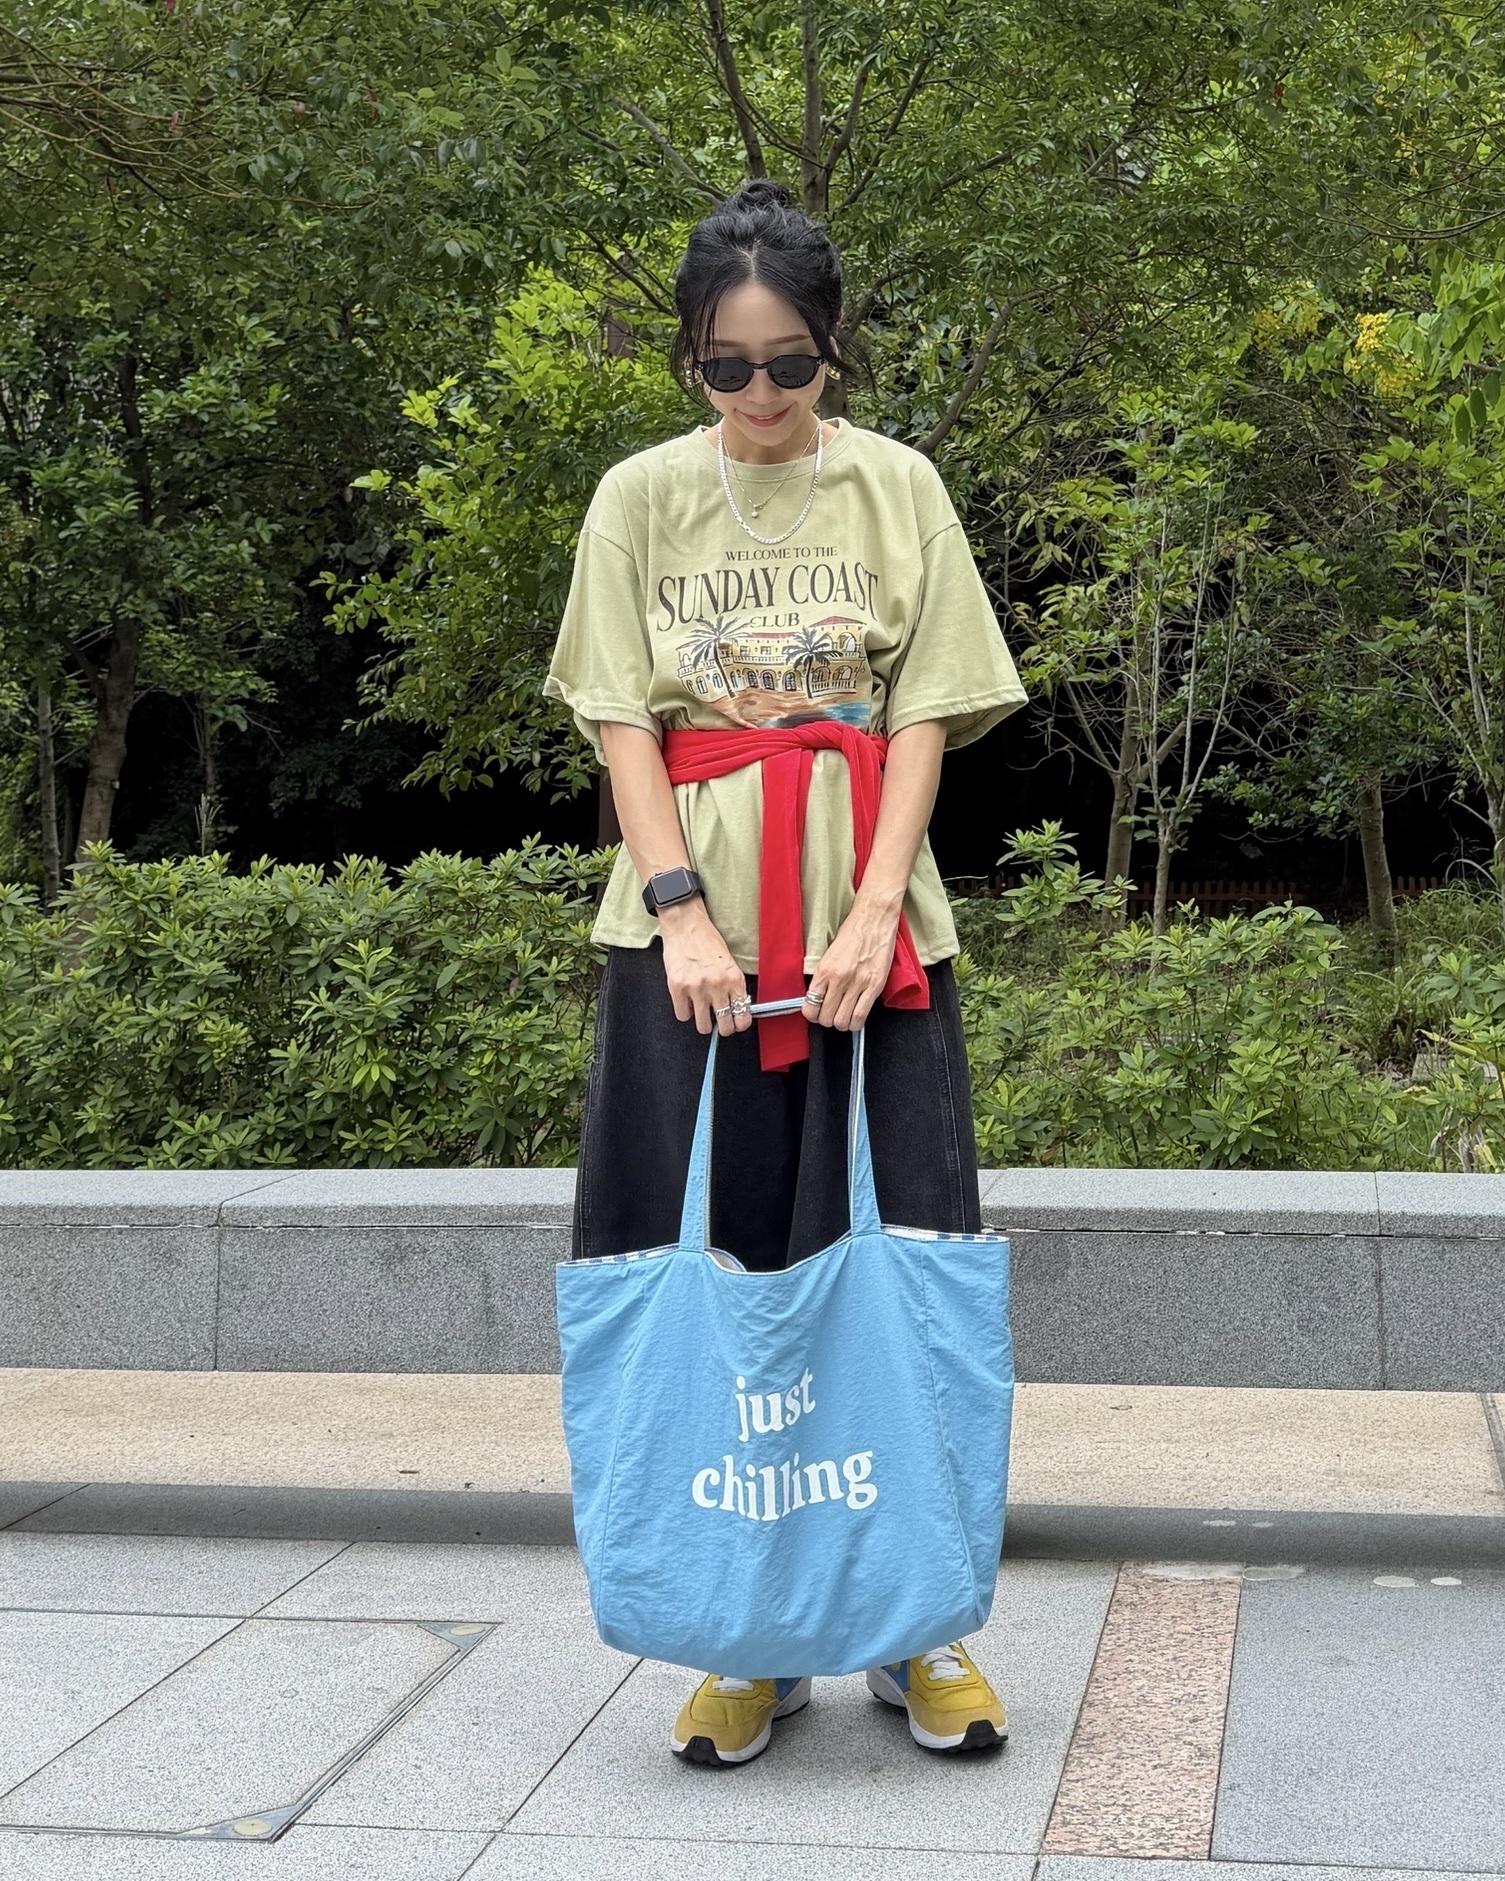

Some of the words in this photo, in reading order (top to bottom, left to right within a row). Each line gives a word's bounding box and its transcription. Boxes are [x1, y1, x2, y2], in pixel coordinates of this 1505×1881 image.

[725, 548, 791, 561] WELCOME
[793, 547, 811, 559] TO
[813, 546, 838, 557] THE
[657, 567, 781, 632] SUNDAY
[788, 561, 878, 622] COAST
[749, 612, 800, 628] CLUB
[735, 1367, 816, 1442] just
[692, 1450, 878, 1521] chilling
